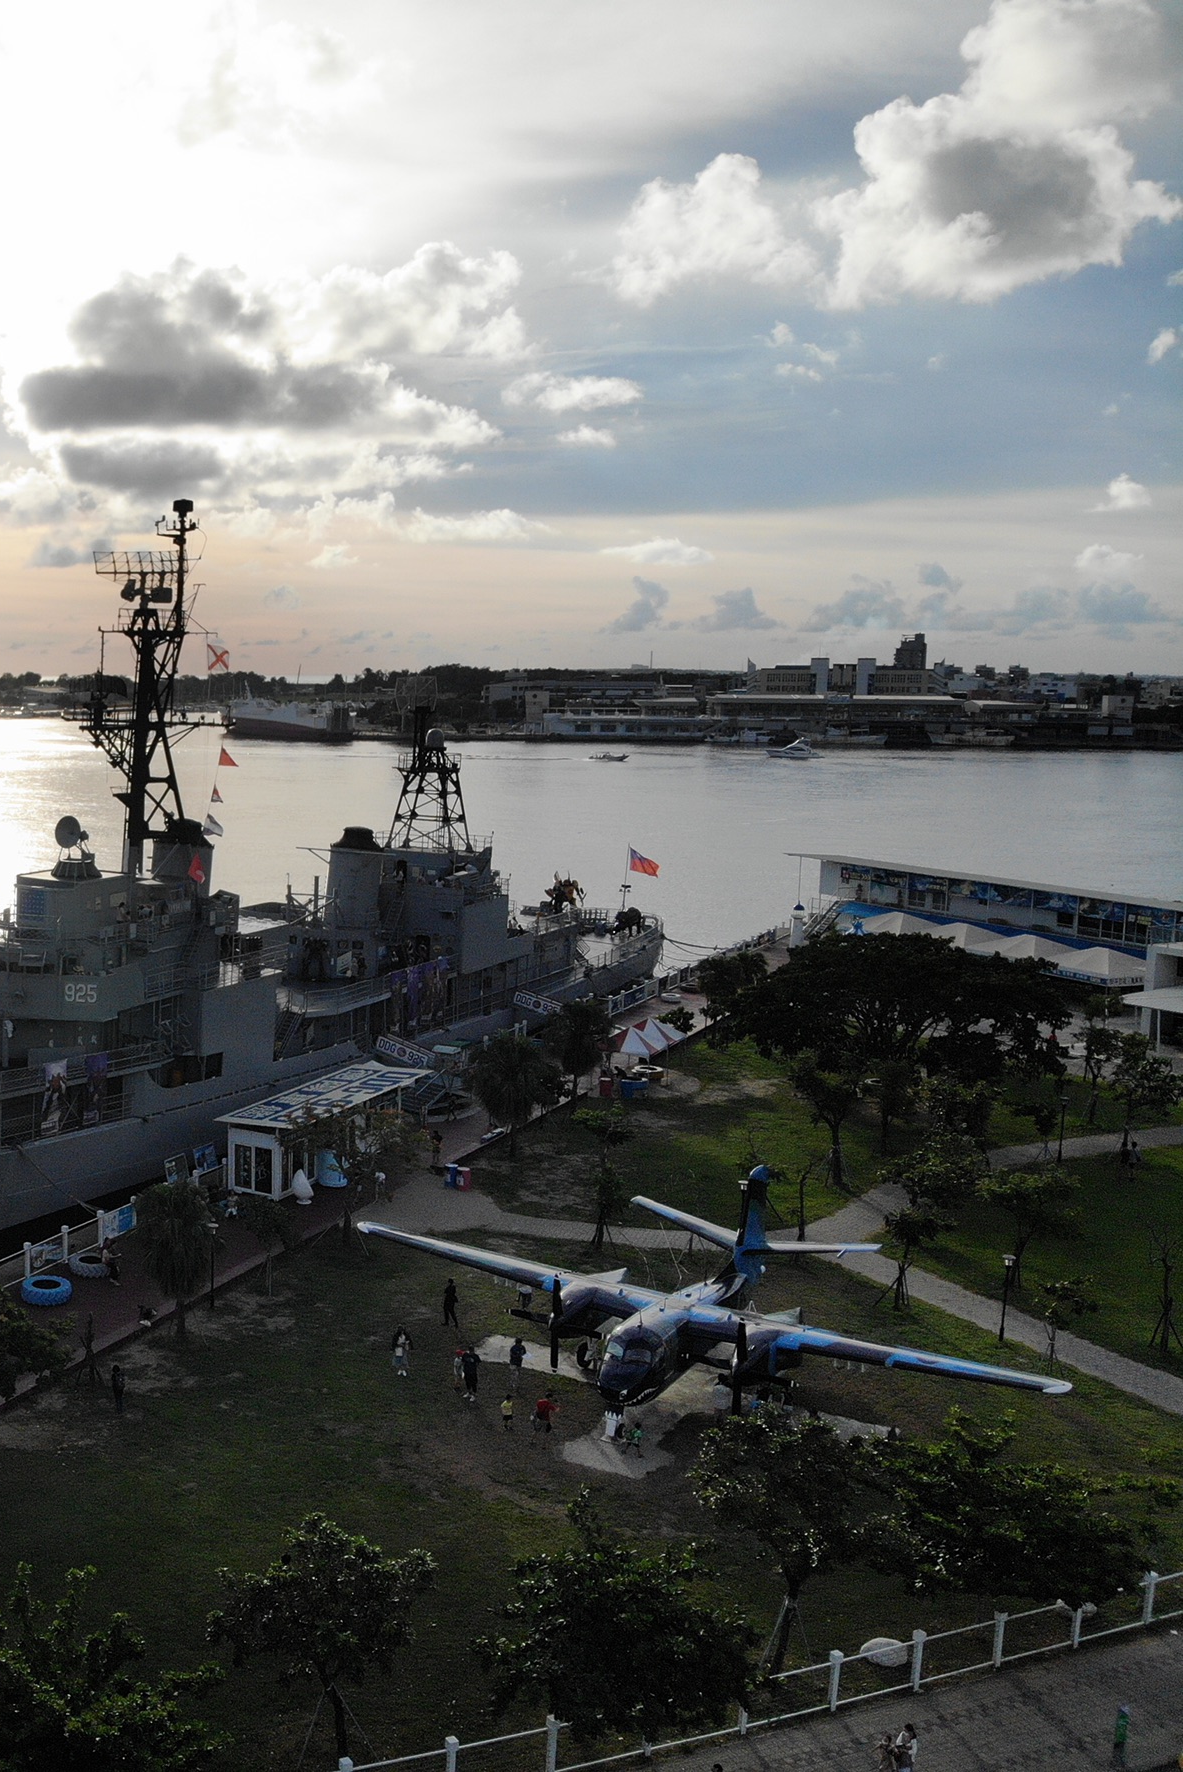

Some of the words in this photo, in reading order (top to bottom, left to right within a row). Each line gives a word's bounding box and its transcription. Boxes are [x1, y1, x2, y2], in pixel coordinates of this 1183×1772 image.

[64, 983, 98, 1004] 925
[378, 1038, 397, 1054] DDG
[407, 1050, 426, 1067] 925
